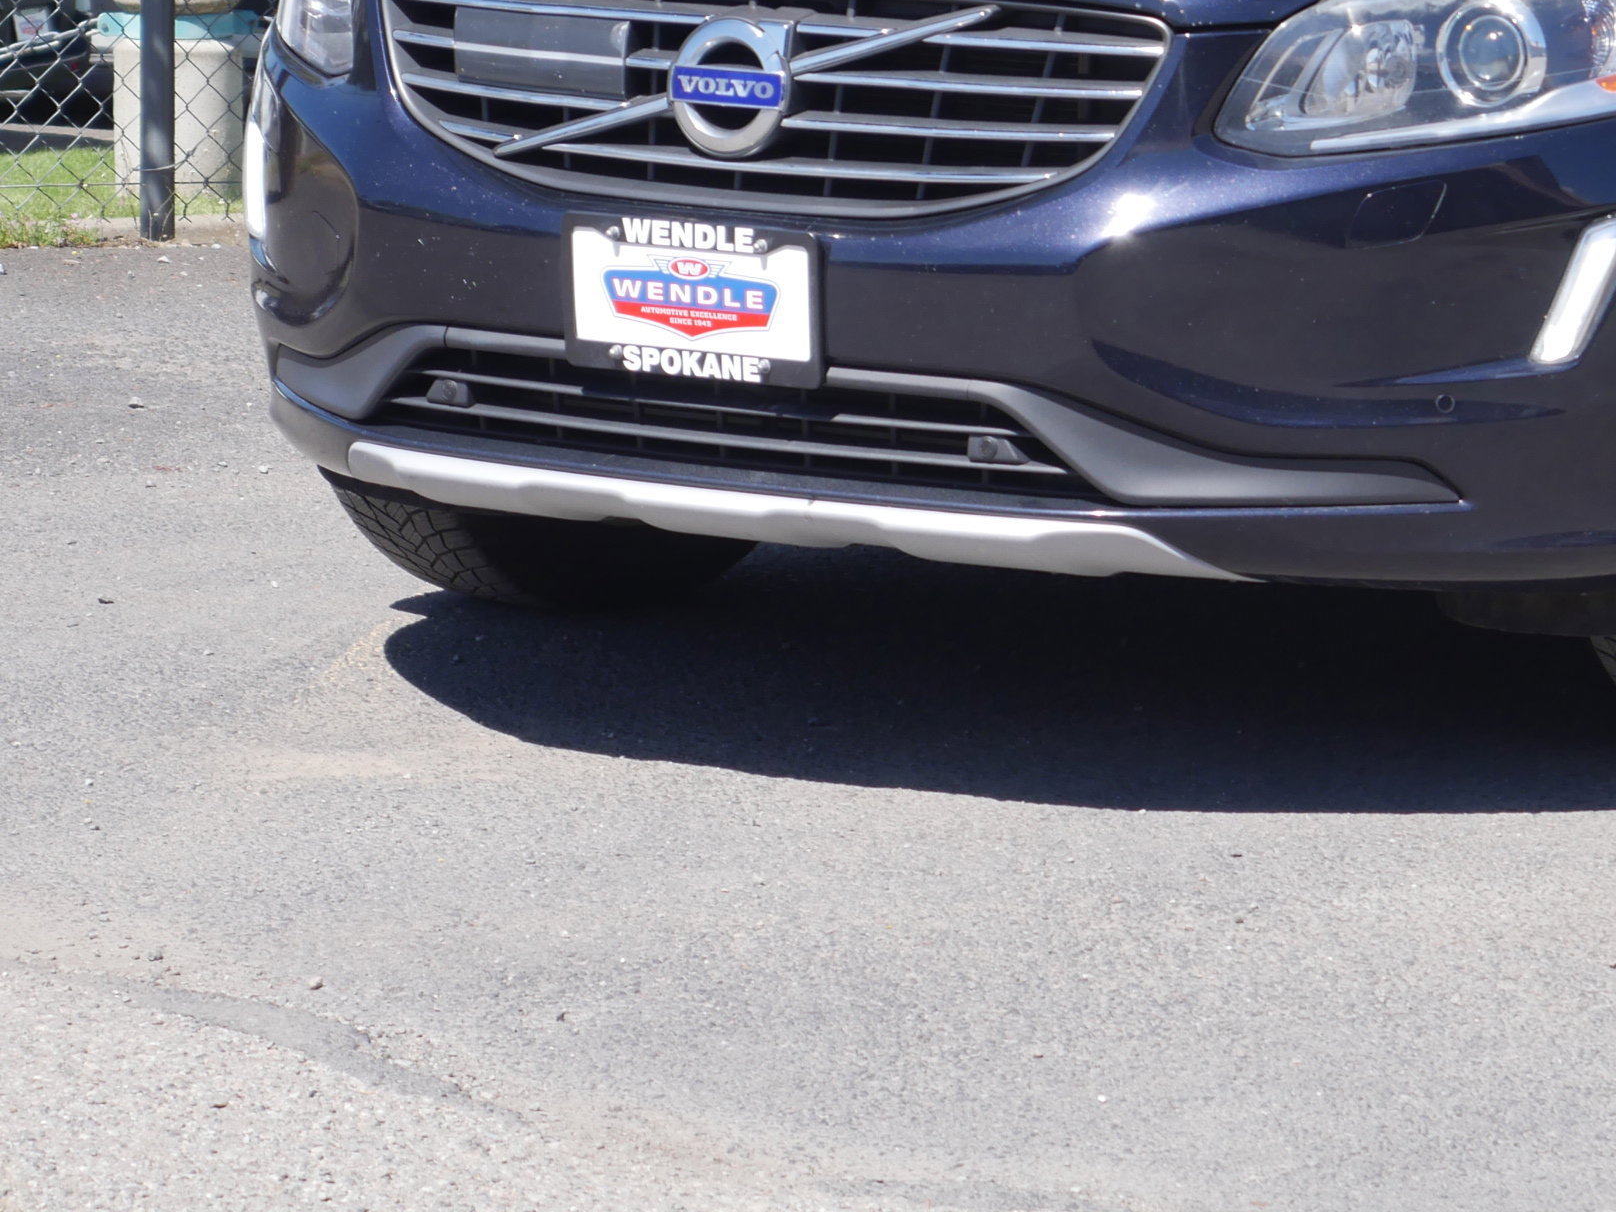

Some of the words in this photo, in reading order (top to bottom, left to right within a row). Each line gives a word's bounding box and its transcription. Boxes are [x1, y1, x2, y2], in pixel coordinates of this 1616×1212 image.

[677, 74, 774, 99] VOLVO
[622, 217, 755, 254] WENDLE
[612, 277, 764, 310] WENDLE
[641, 306, 689, 317] AUTOMOTIVE
[689, 310, 738, 321] EXCELLENCE
[669, 317, 692, 326] SINCE
[622, 344, 762, 382] SPOKANE
